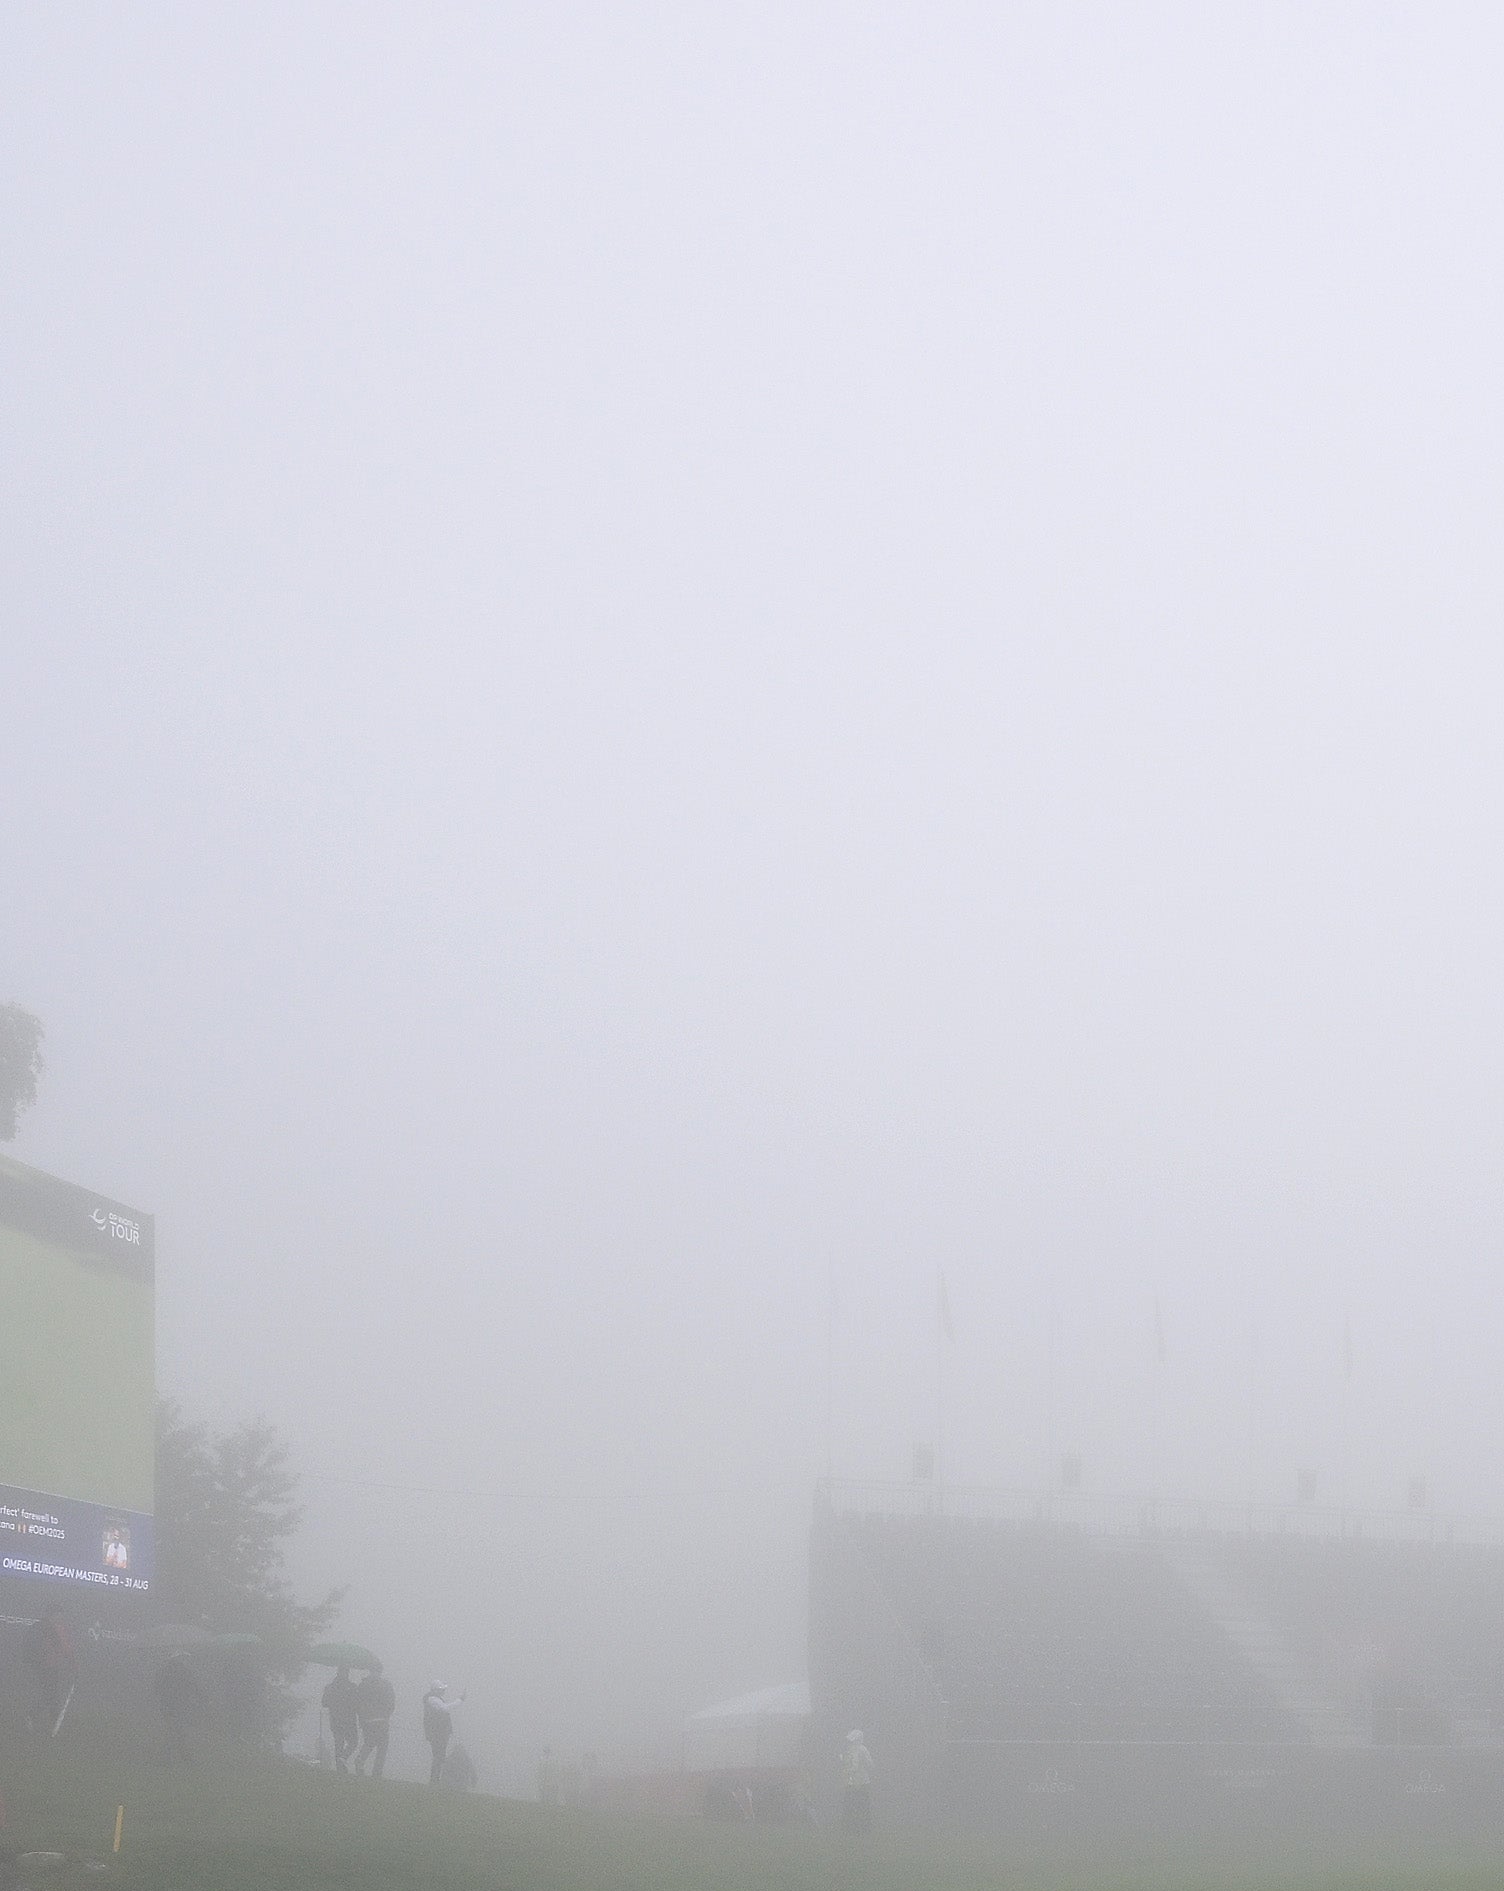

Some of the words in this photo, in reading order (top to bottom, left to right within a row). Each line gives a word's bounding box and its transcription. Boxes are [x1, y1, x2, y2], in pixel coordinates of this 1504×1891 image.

[110, 1221, 140, 1246] TOUR
[21, 1508, 49, 1523] farewell
[50, 1515, 59, 1524] to
[28, 1524, 65, 1539] #OEM2025
[3, 1558, 32, 1572] OMEGA
[33, 1562, 75, 1579] EUROPEAN
[75, 1569, 108, 1585] MASTERS,
[109, 1575, 119, 1585] 28
[125, 1578, 133, 1588] 31
[132, 1579, 149, 1590] AUG
[1027, 1782, 1076, 1794] OMEGA
[1404, 1783, 1447, 1794] OMEGA
